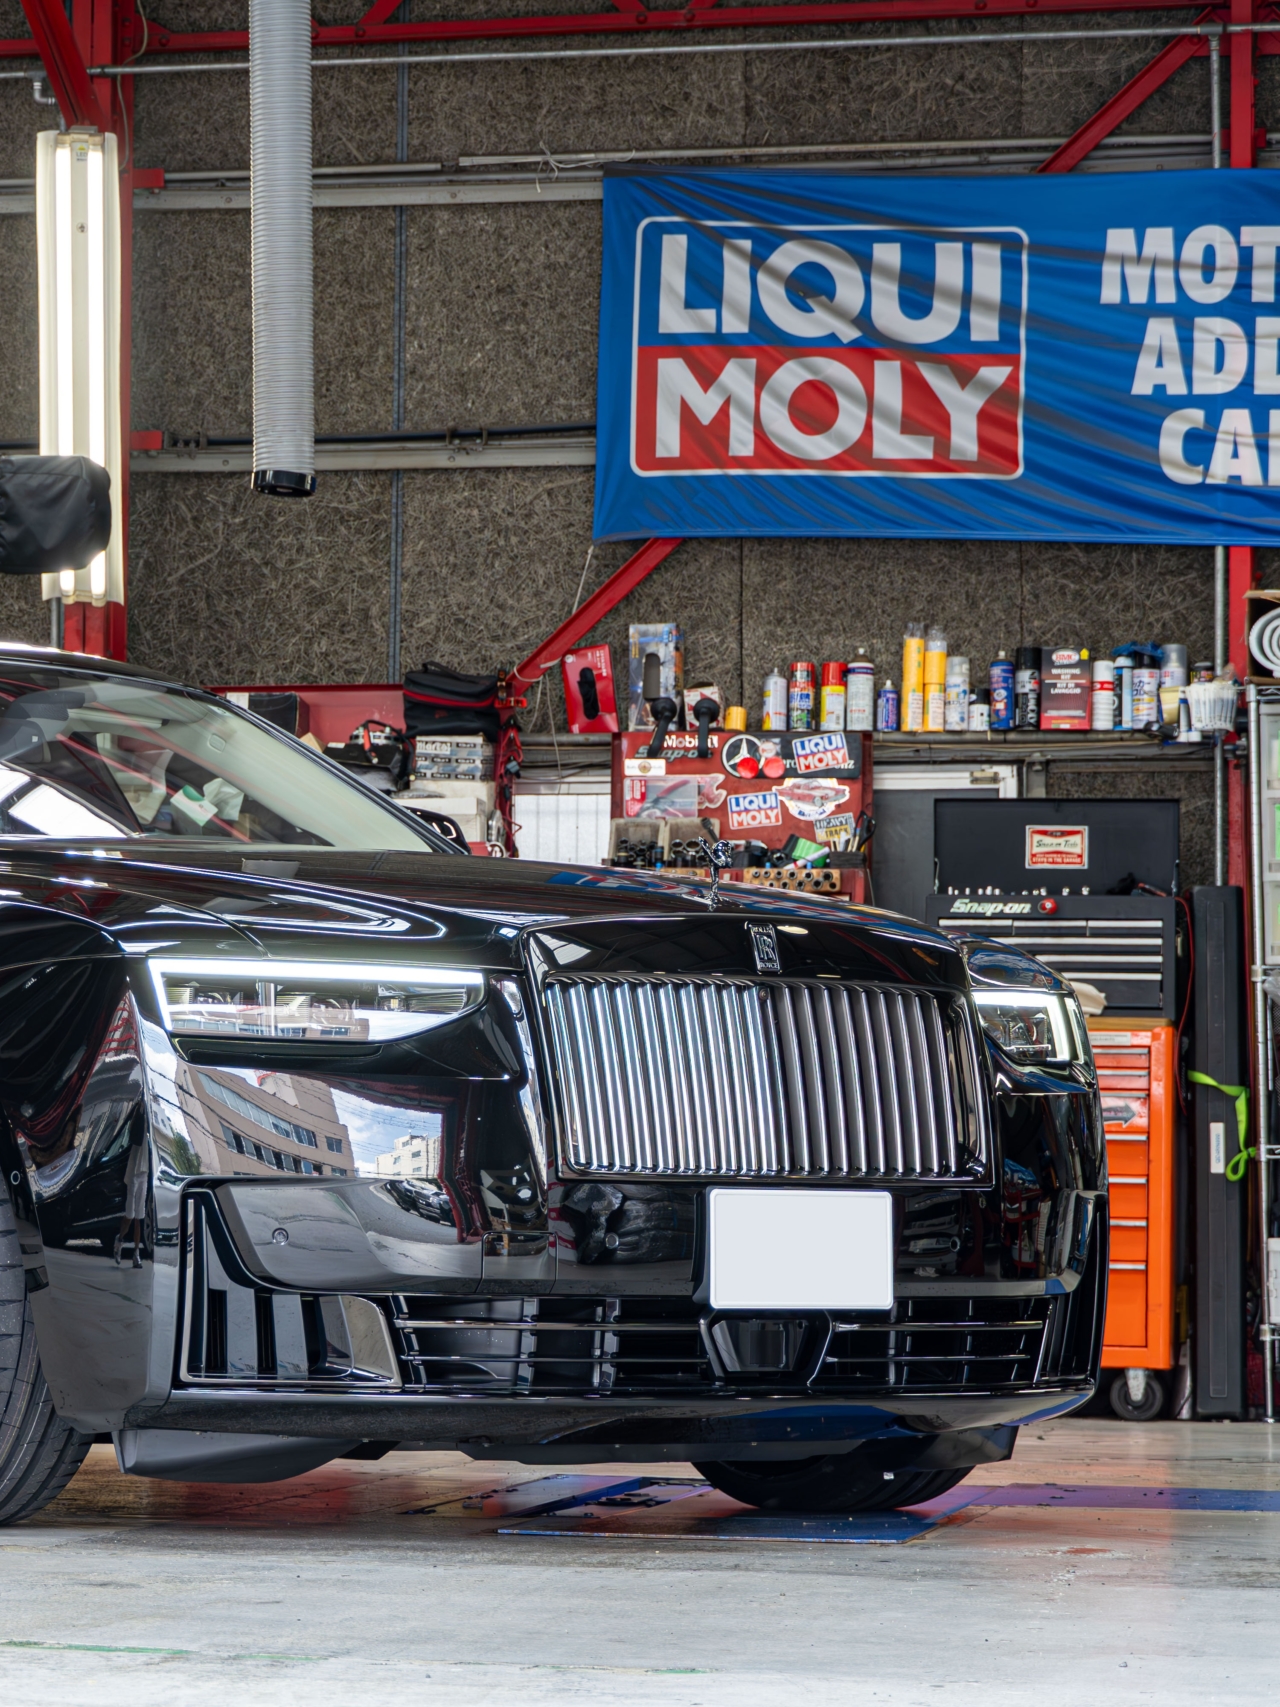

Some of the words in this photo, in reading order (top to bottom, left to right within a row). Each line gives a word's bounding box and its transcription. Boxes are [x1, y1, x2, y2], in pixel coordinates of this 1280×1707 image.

[1099, 224, 1280, 304] MOT
[658, 233, 1002, 344] LIQUI
[655, 356, 1014, 462] MOLY
[1158, 408, 1280, 487] CA
[796, 734, 844, 755] LIQUI
[799, 749, 848, 771] MOLY
[730, 793, 777, 812] LIQUI
[732, 809, 779, 827] MOLY
[950, 898, 1032, 916] Snap-on
